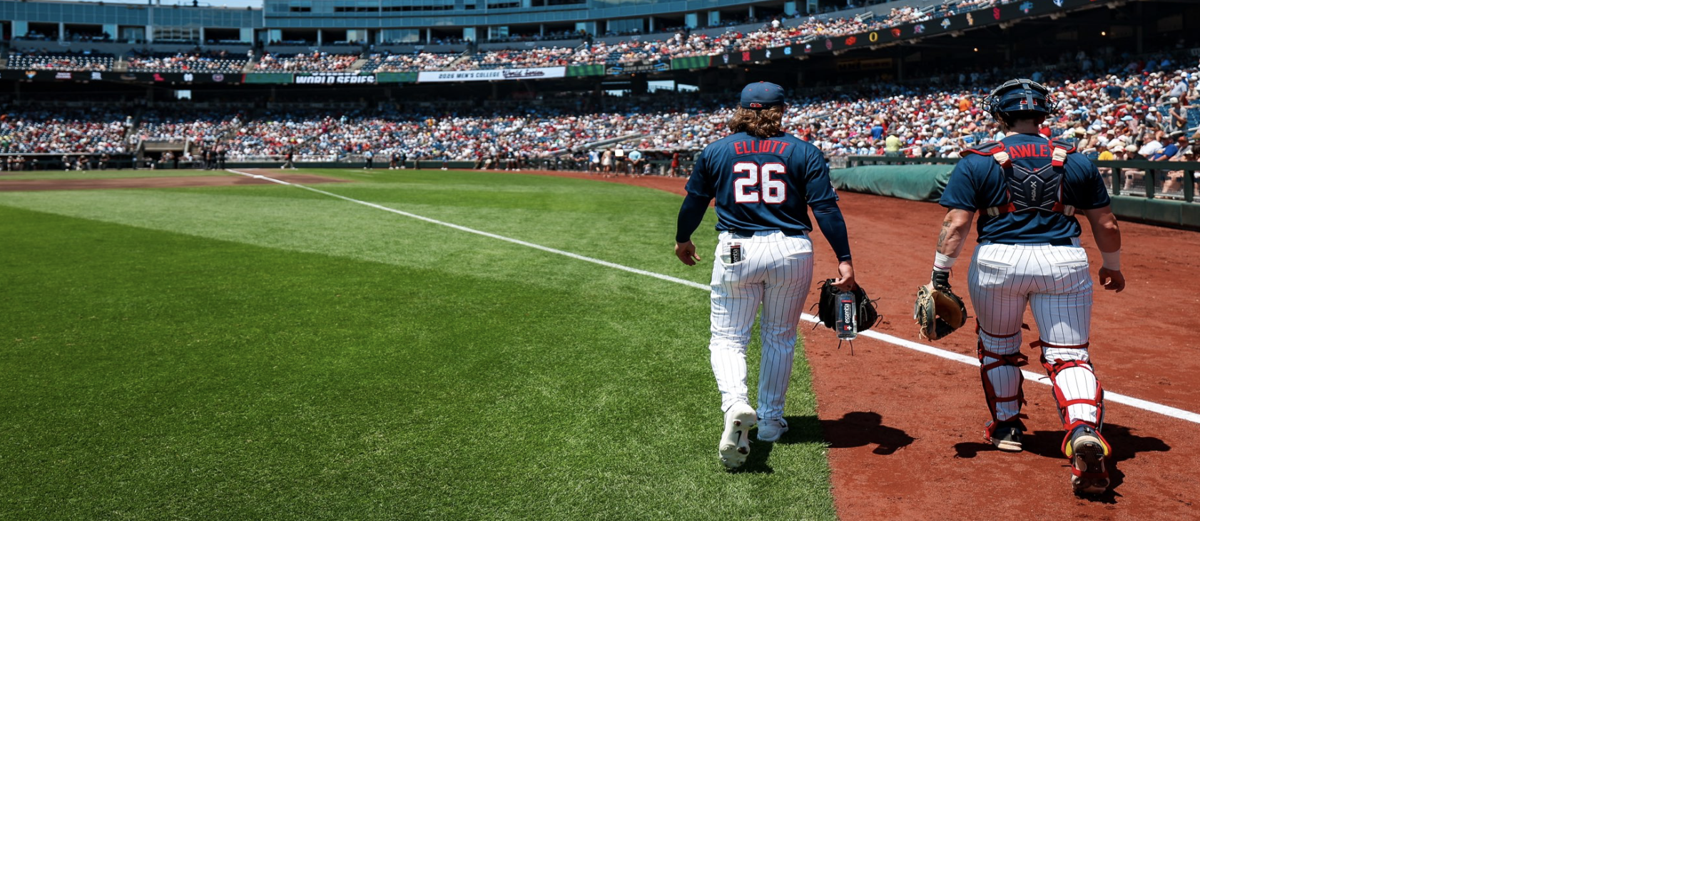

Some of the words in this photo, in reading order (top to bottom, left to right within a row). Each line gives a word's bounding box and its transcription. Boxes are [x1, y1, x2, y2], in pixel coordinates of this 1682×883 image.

[337, 76, 374, 84] SERIES
[733, 140, 790, 155] ELLIOTT
[1006, 143, 1053, 159] AWLE
[732, 161, 787, 204] 26
